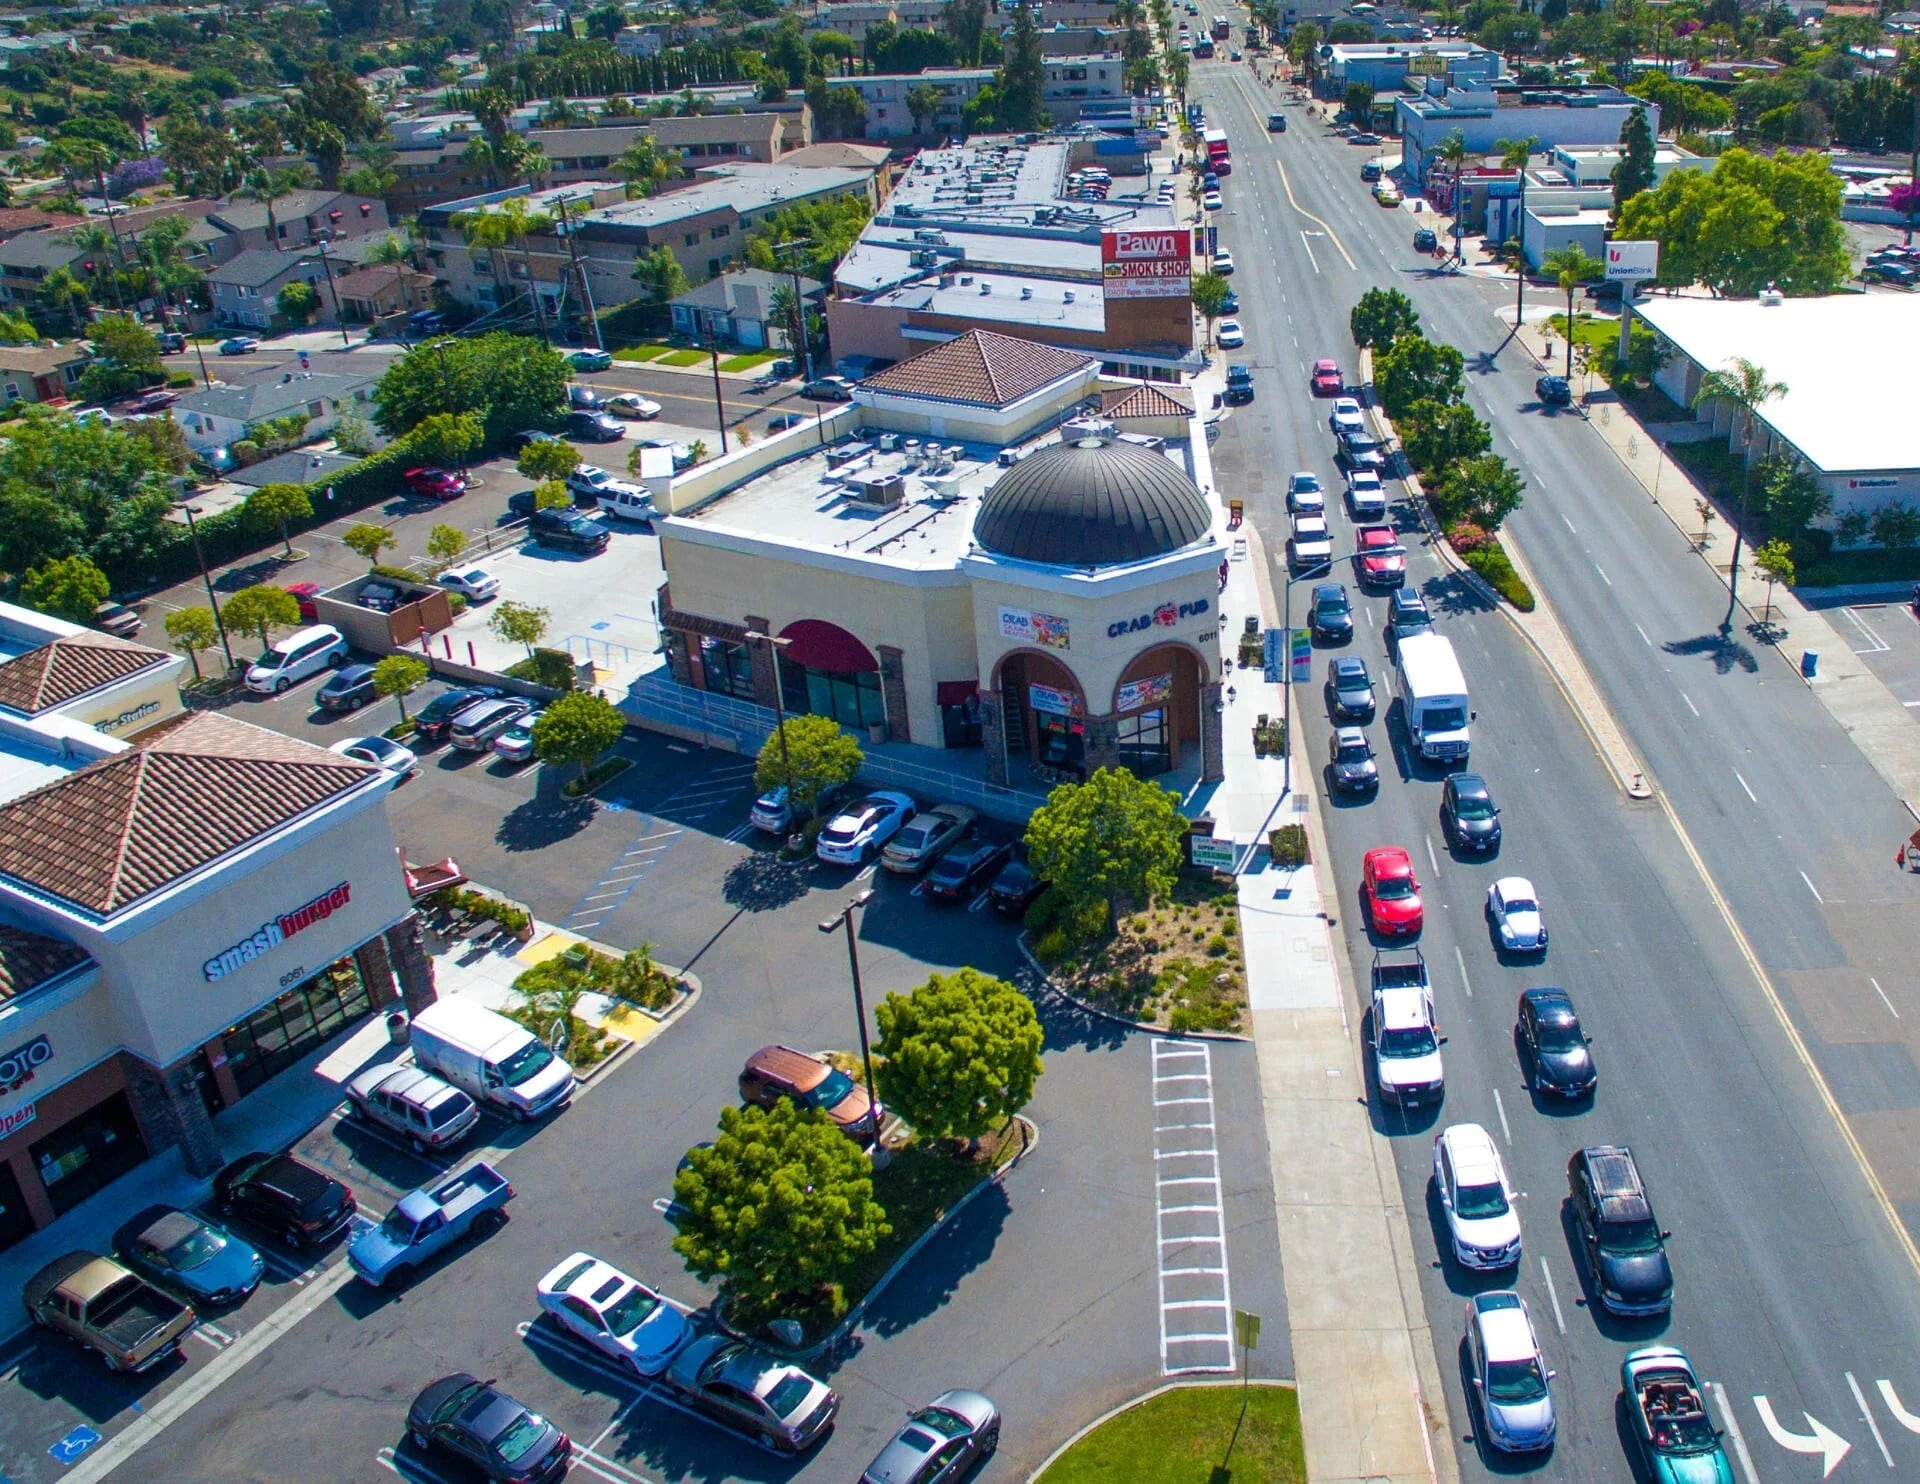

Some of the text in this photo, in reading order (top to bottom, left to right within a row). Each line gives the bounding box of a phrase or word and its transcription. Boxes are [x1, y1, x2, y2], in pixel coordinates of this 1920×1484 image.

[1116, 233, 1176, 254] Pawn
[1121, 261, 1190, 277] SMOKE SHOP
[1608, 267, 1653, 275] UnionBank
[1002, 613, 1029, 627] CRAB
[1107, 598, 1209, 638] CRAB PUB
[1198, 631, 1217, 643] 6011
[119, 701, 160, 726] Station
[204, 880, 351, 983] smashburger
[280, 966, 305, 987] 6061
